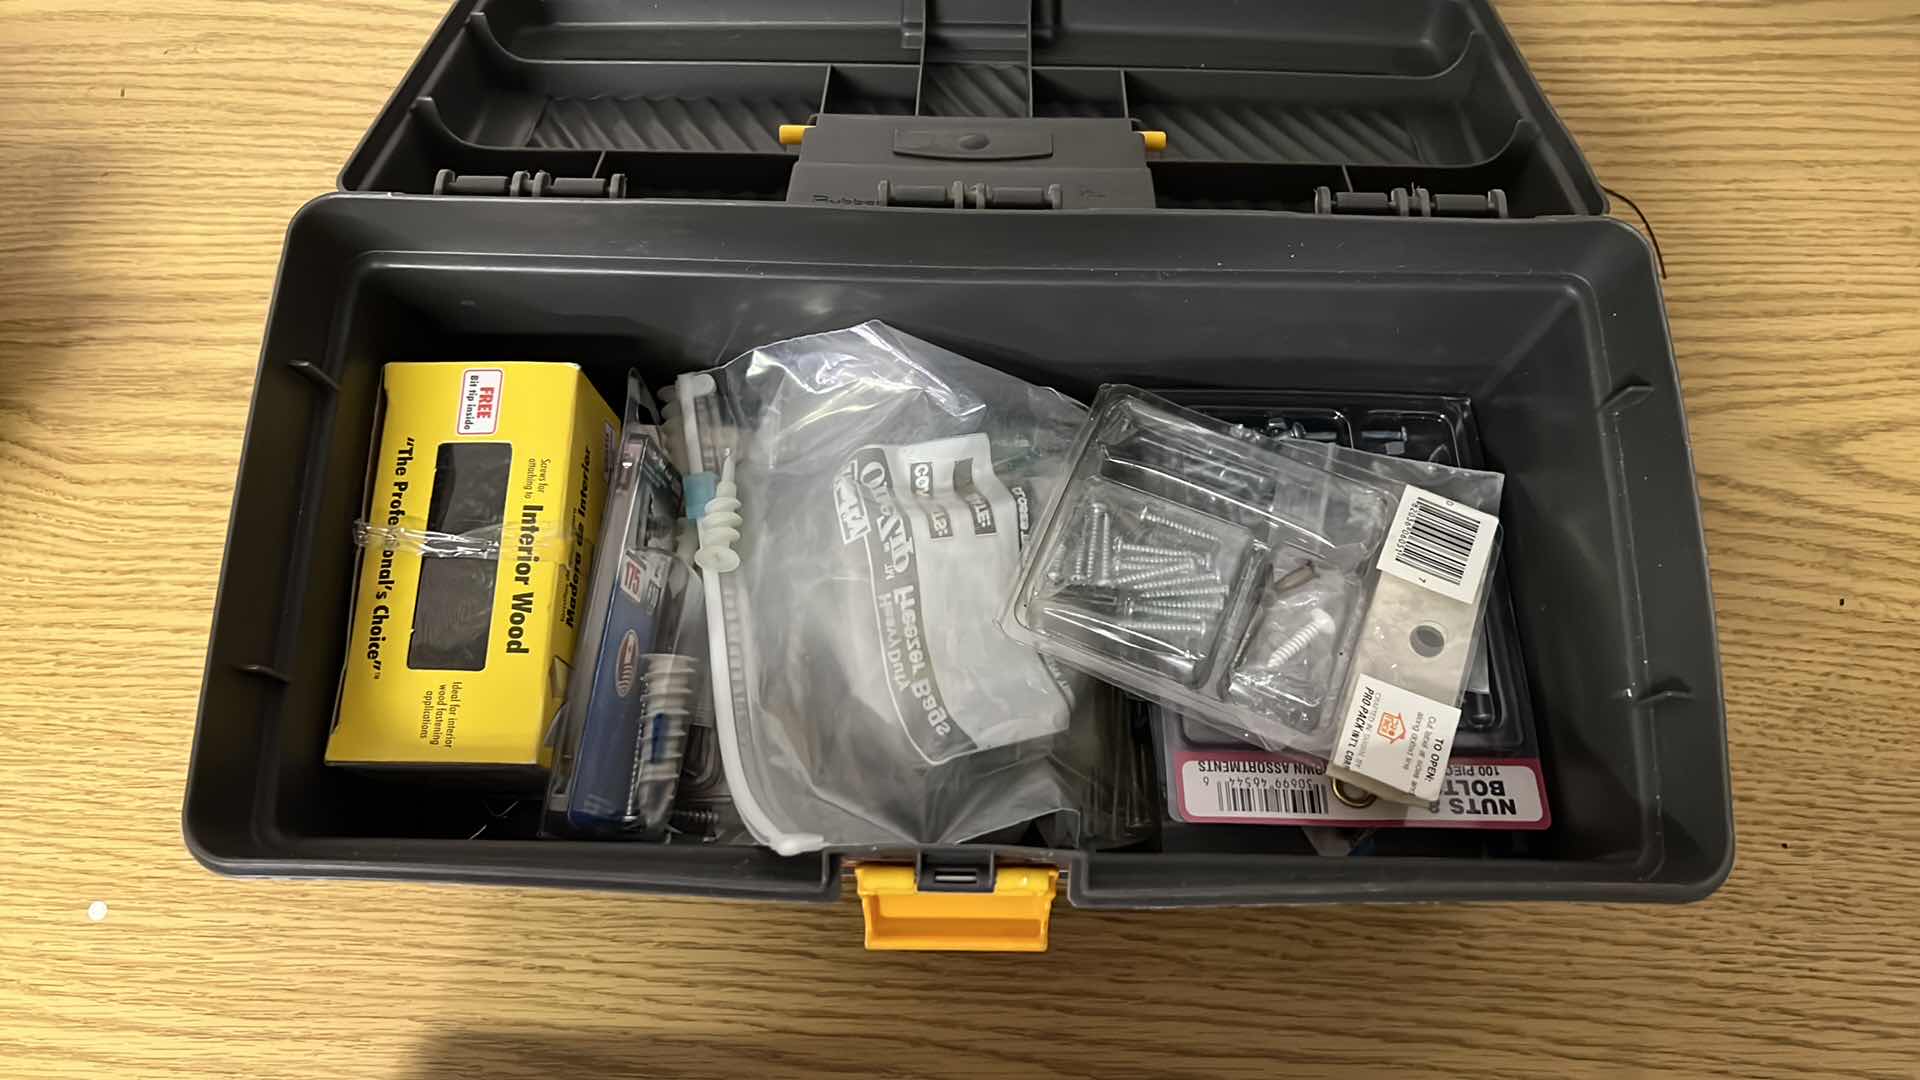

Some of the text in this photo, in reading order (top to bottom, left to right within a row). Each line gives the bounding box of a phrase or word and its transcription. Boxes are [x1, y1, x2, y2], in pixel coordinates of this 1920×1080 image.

[463, 375, 480, 430] Bit tip inside
[478, 387, 494, 419] FREE
[394, 437, 415, 477] "The
[524, 458, 536, 489] attaching
[539, 458, 551, 481] Screws
[375, 481, 409, 600] Profeonal's
[566, 551, 581, 629] Madera
[578, 447, 591, 518] Interior
[506, 505, 544, 654] Interior Wood
[419, 690, 435, 739] applications
[429, 684, 448, 746] wood fastening
[443, 681, 463, 748] Ideal for interior
[1198, 760, 1289, 774] ASSORTMENTS
[1424, 738, 1444, 783] TO OPEN:
[1478, 766, 1501, 777] 100
[1203, 775, 1313, 789] 30699 46544 6
[1443, 779, 1506, 797] BOLT
[1448, 798, 1517, 815] NUTS
